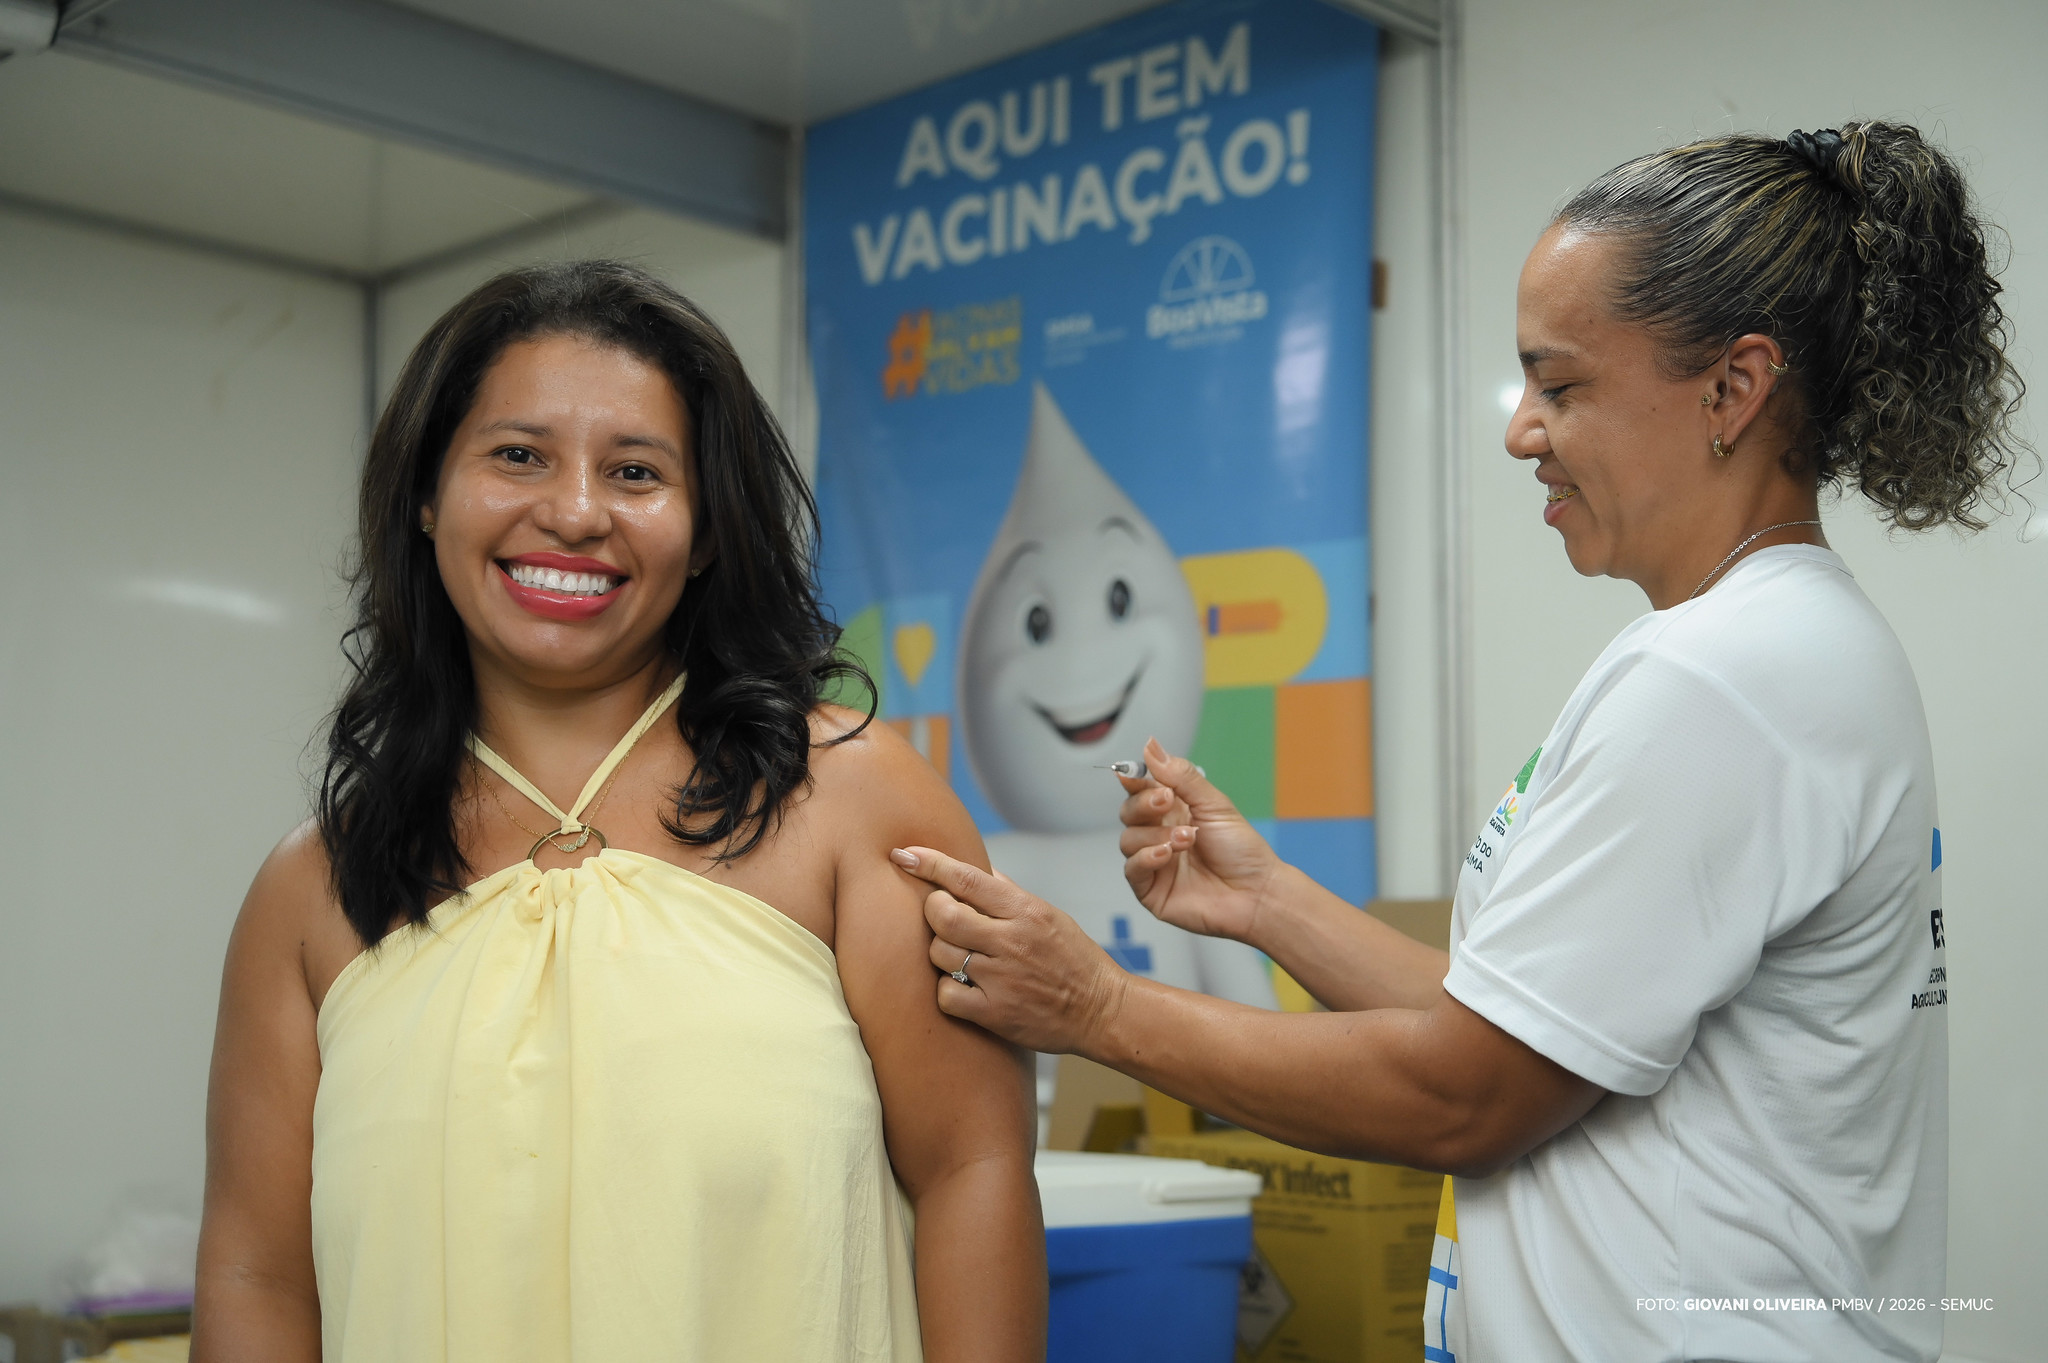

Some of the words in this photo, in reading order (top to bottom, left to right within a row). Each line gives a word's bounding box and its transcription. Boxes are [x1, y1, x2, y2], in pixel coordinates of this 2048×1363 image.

[896, 76, 1070, 188] AQUI
[1090, 22, 1250, 132] TEM
[853, 110, 1311, 286] VACINAÇÃO!
[1480, 842, 1492, 857] DO
